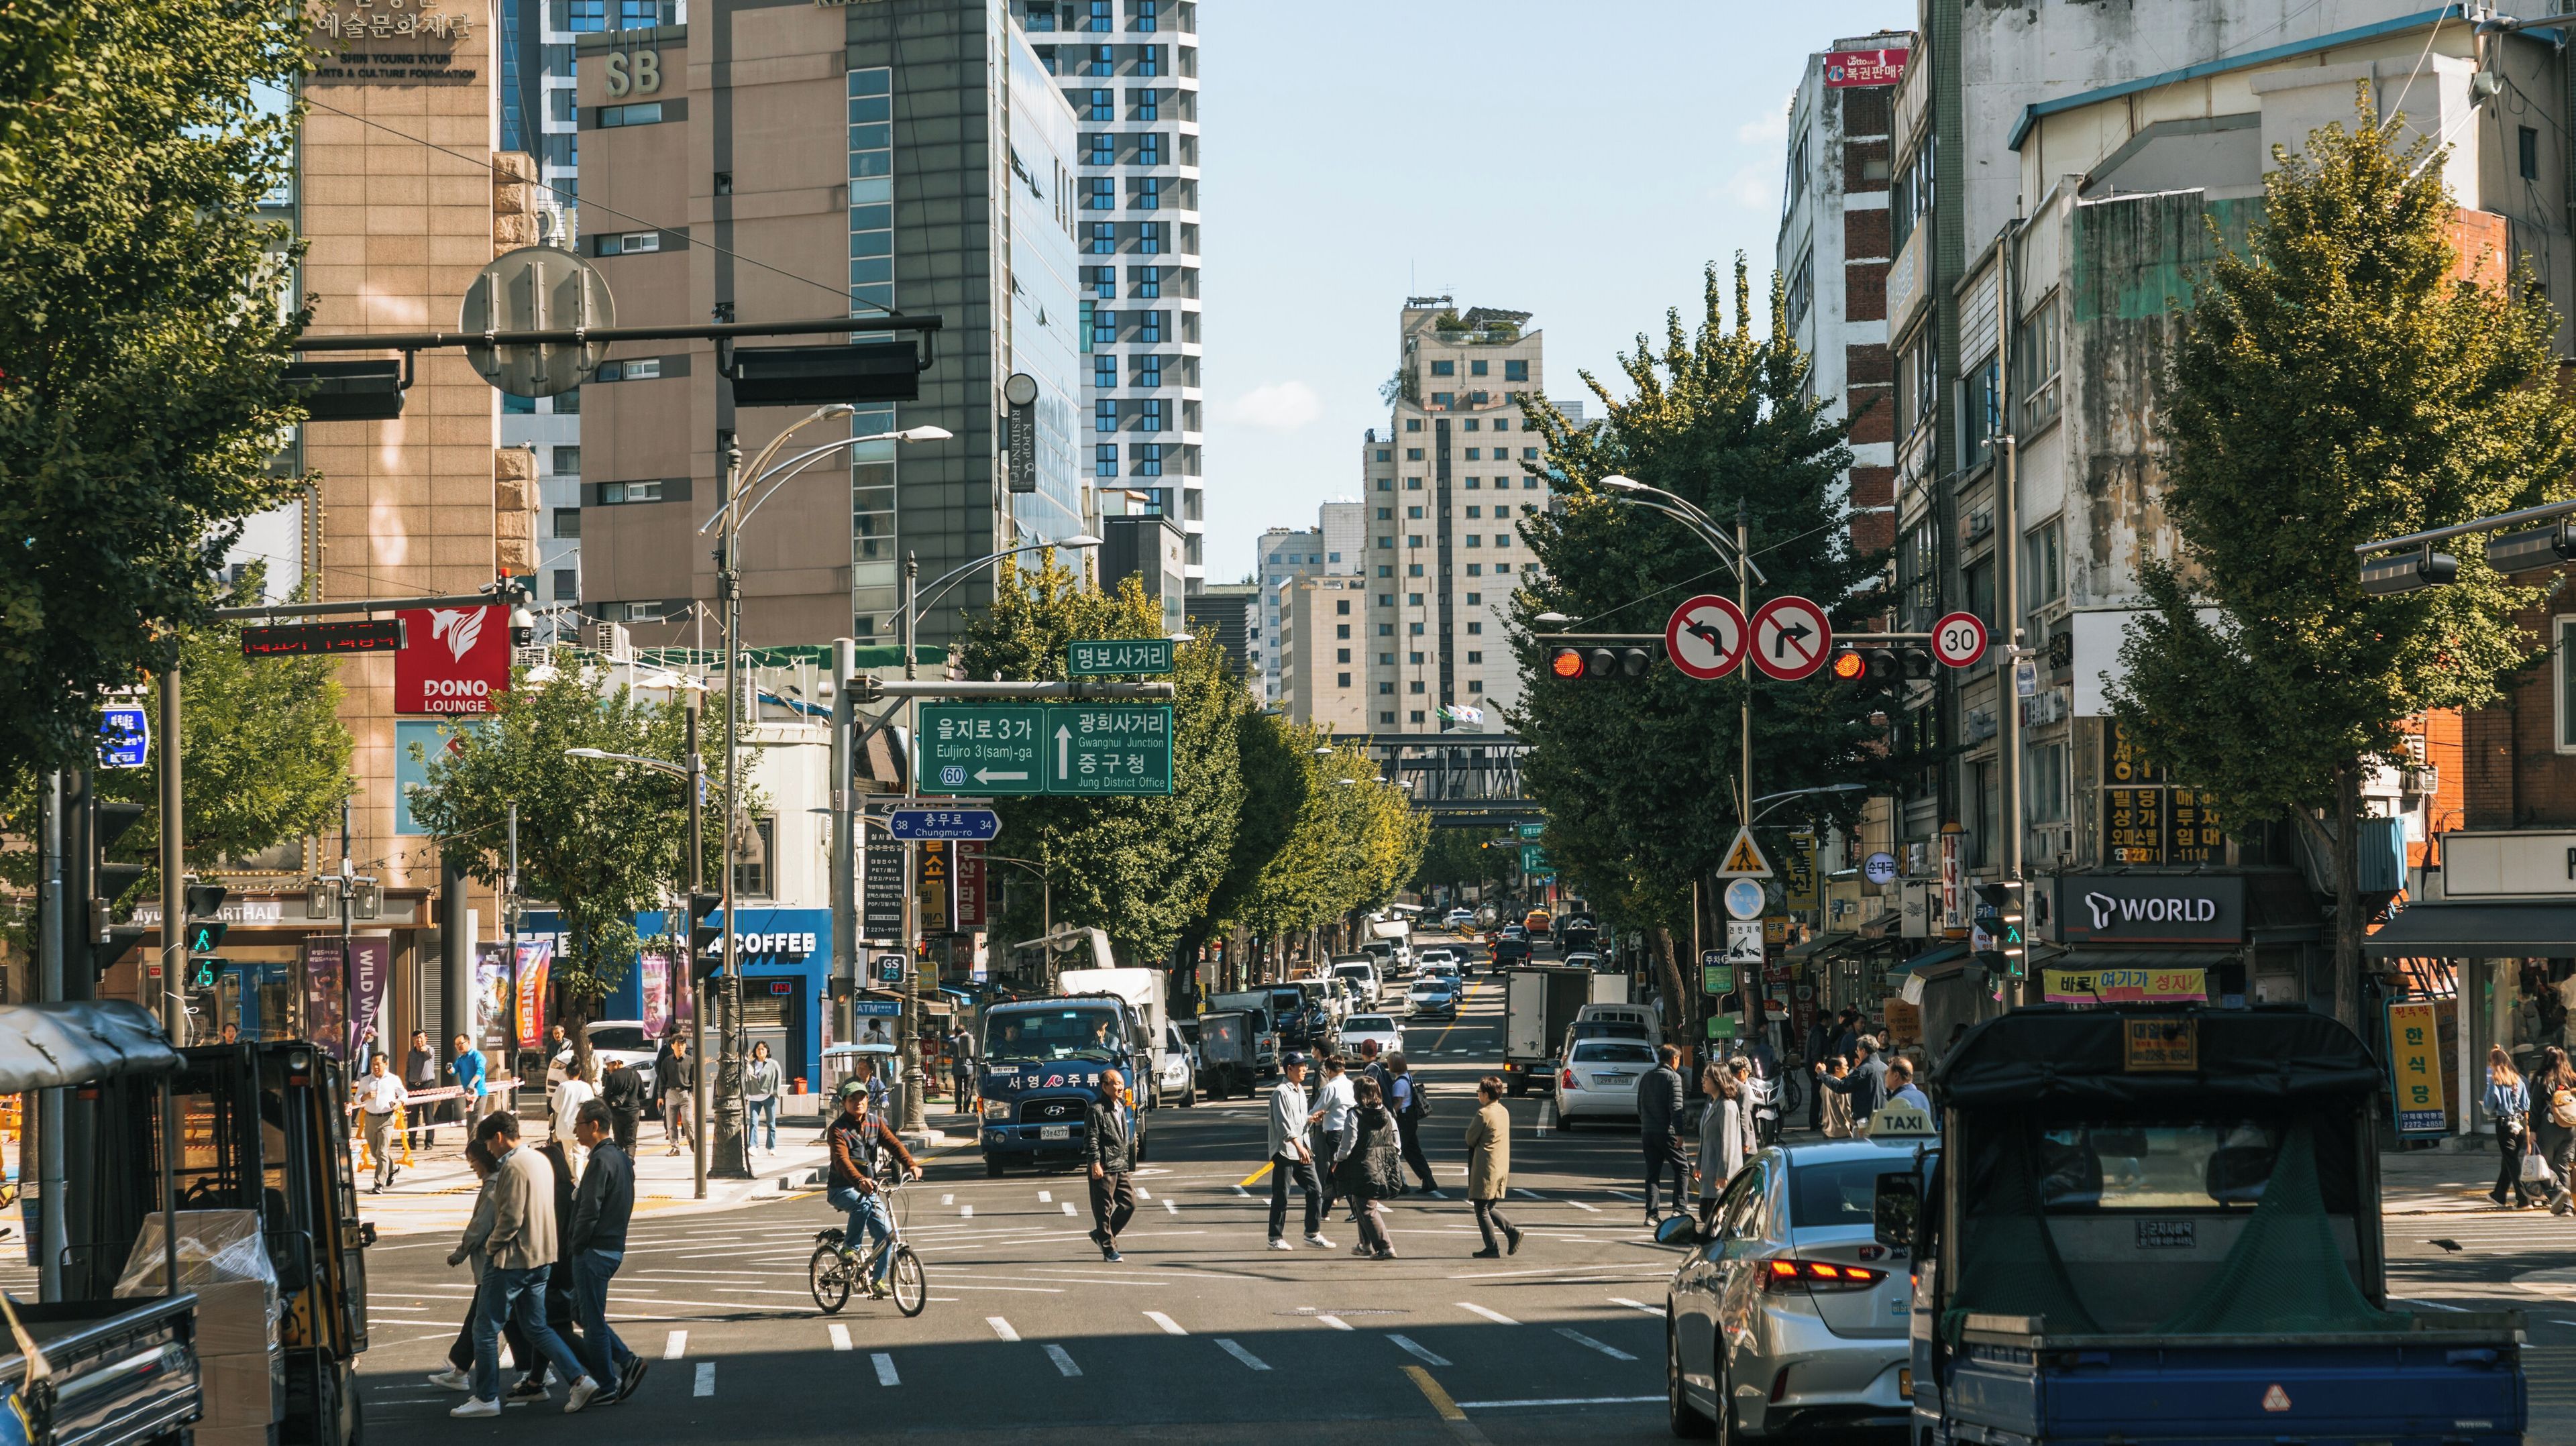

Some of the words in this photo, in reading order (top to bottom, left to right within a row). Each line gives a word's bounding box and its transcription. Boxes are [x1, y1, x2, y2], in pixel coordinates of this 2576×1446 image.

[316, 12, 474, 39] 예술문화재단
[339, 54, 367, 64] SHIN
[372, 54, 415, 64] YOUNG
[419, 54, 451, 64] KYUN
[315, 69, 343, 78] ARTS
[347, 69, 355, 78] &
[358, 69, 406, 78] CULTURE
[410, 69, 476, 78] FOUNDATION
[604, 50, 660, 97] SB
[1012, 409, 1020, 471] RESIDENCE
[1022, 424, 1032, 458] K-POP
[1945, 629, 1974, 652] 30
[1077, 646, 1165, 669] 명보사거리
[423, 679, 488, 697] DONO
[425, 700, 486, 712] LOUNGE
[1079, 714, 1164, 734] 광희사거리
[1079, 737, 1121, 750] Gwanghui
[1127, 737, 1164, 748] Junction
[936, 744, 971, 761] Euljiro
[1078, 754, 1144, 774] 중구청
[945, 769, 962, 783] 60
[1078, 777, 1099, 789] Jung
[1104, 777, 1136, 787] District
[1139, 777, 1165, 787] Office
[896, 820, 908, 830] 38
[924, 814, 964, 826] 충무로
[979, 820, 991, 830] 34
[915, 828, 972, 838] Chungmu-ro
[2112, 829, 2157, 846] 오피스텔
[1868, 862, 1894, 874] 순대국
[2120, 899, 2216, 922] WORLD
[1729, 926, 1760, 934] 견인지역
[1768, 923, 1784, 933] 부동
[734, 932, 816, 953] COFFEE
[883, 958, 900, 969] GS
[1706, 955, 1721, 964] 주차
[360, 949, 374, 993] WILD
[883, 969, 899, 979] 25
[2101, 970, 2148, 988] 여기가
[2155, 975, 2193, 991] 성지!
[857, 1005, 877, 1013] ATM
[2395, 1006, 2429, 1018] 원두막
[2406, 1027, 2429, 1104] 한식당
[1884, 1116, 1923, 1130] TAXI
